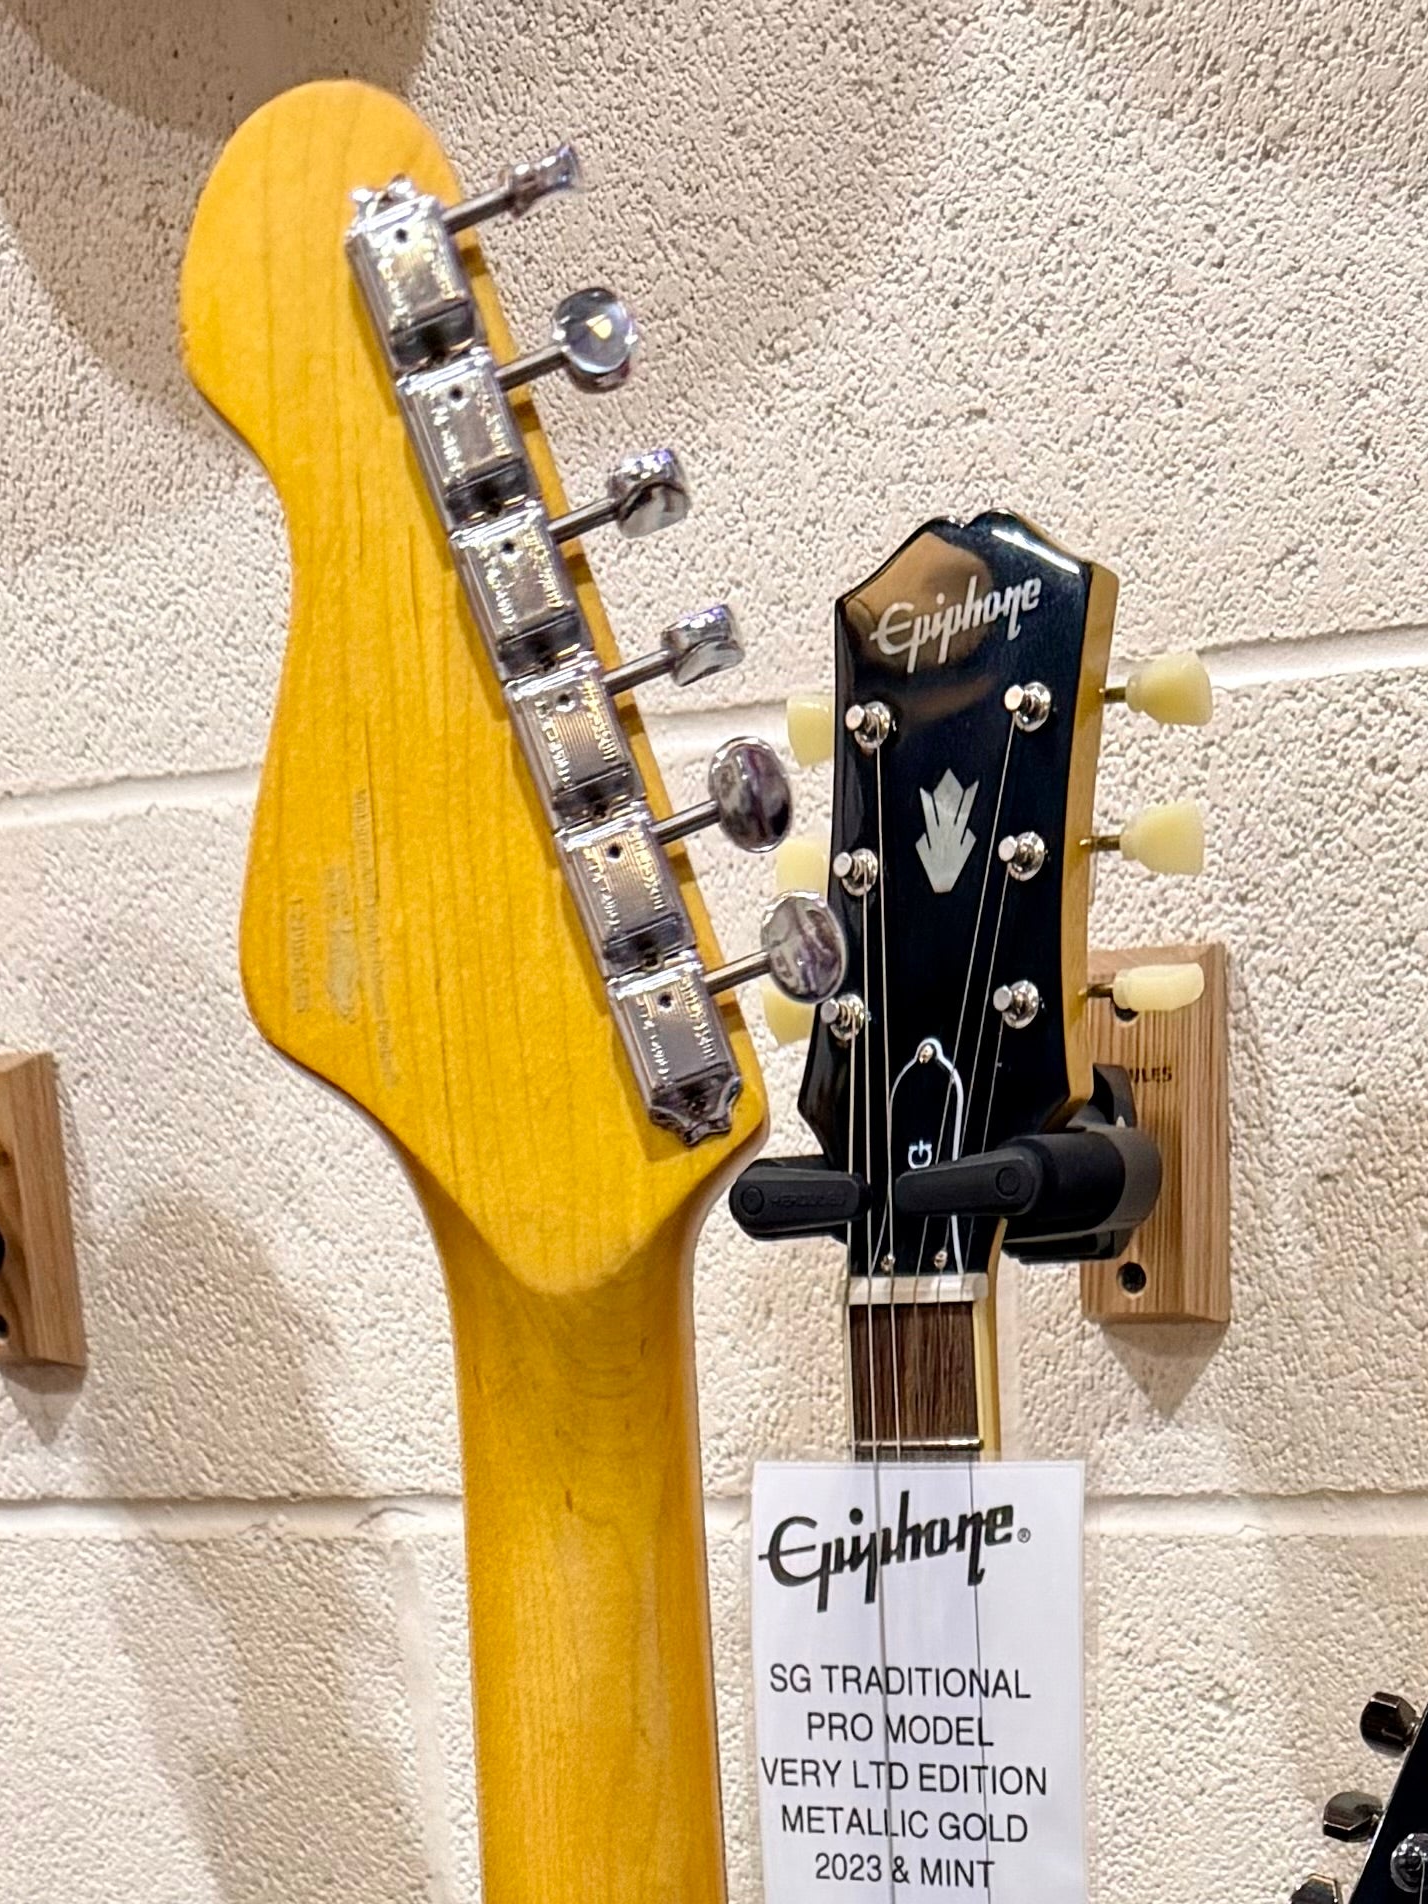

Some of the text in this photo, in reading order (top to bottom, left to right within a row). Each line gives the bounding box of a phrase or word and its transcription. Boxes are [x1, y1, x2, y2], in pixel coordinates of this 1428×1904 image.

[870, 576, 1042, 673] Epiphone
[758, 1490, 1015, 1613] Epiphone
[769, 1663, 1032, 1700] SG TRADITIONAL
[807, 1712, 995, 1748] PRO MODEL
[760, 1757, 1048, 1796] VERY LTD EDITION
[780, 1806, 1029, 1843] METALLIC GOLD
[815, 1853, 997, 1889] 2023 & MINT
